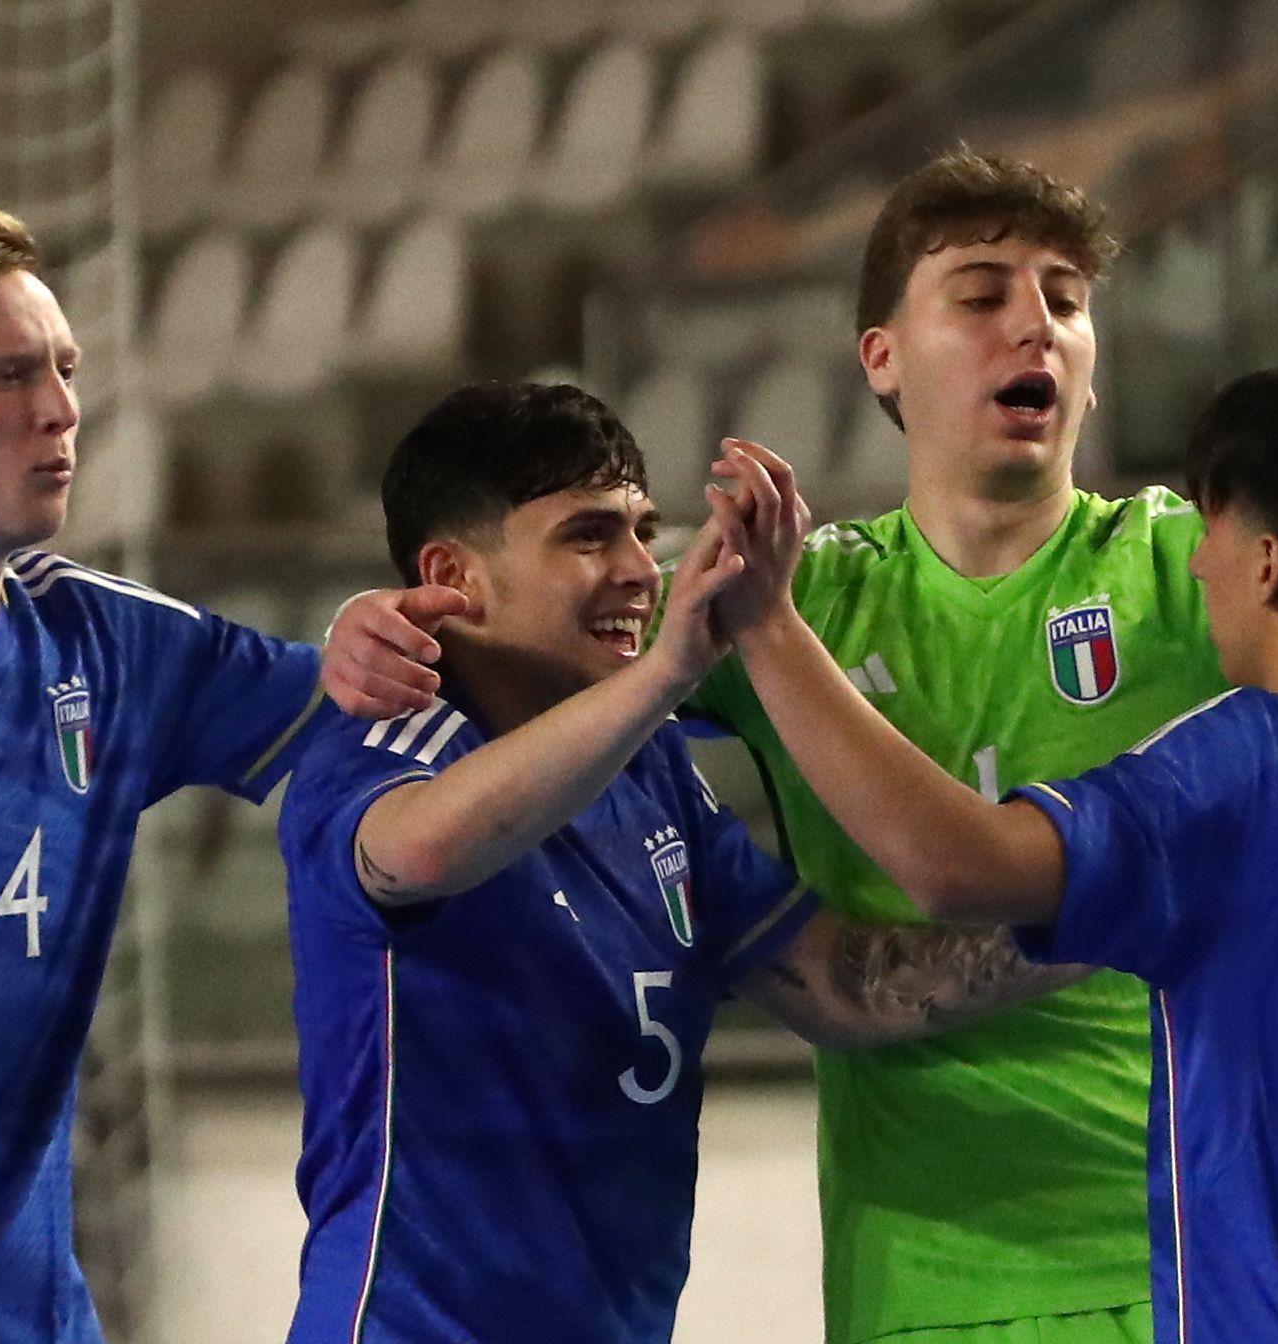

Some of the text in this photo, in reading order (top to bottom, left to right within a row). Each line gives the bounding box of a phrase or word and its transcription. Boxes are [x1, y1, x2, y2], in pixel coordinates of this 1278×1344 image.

[1051, 612, 1108, 640] ITALIA
[656, 850, 688, 879] ITALIA
[618, 970, 683, 1105] 5
